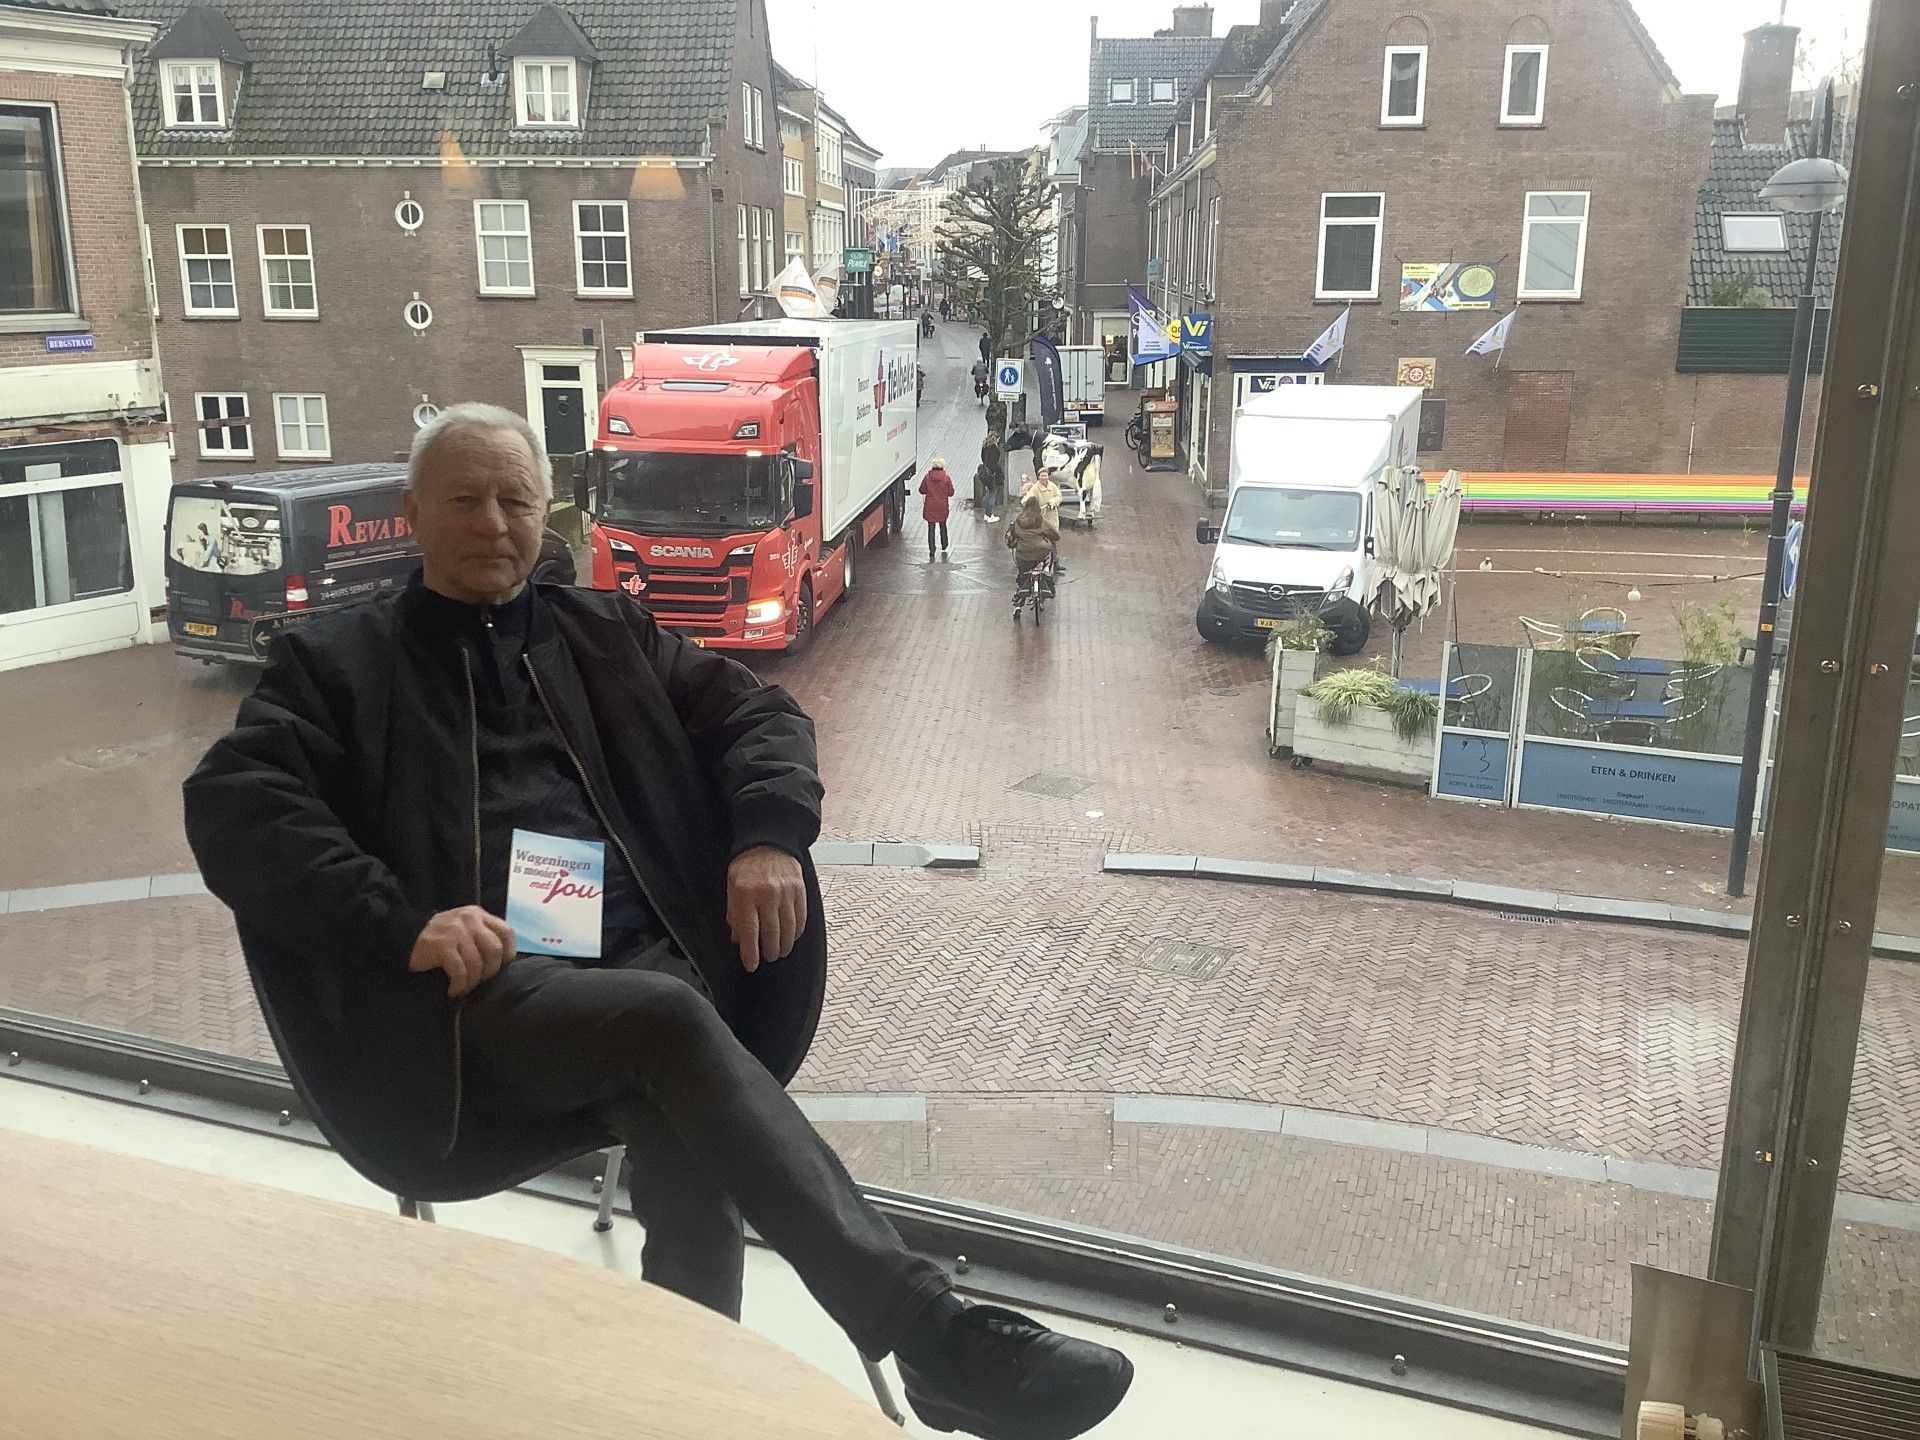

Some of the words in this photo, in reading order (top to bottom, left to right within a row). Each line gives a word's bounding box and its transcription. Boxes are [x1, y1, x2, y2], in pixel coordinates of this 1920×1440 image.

[1183, 316, 1208, 336] Vi
[49, 339, 92, 348] BERGSTRAAT
[327, 504, 391, 548] REVA
[649, 545, 713, 559] SCANIA
[1591, 765, 1616, 777] ETEN
[1618, 769, 1627, 778] &
[1629, 770, 1676, 783] DRINKEN
[1617, 791, 1644, 800] Dagkaart
[1655, 804, 1676, 813] VEGAN
[516, 849, 592, 871] Wageningen
[513, 862, 523, 874] is
[523, 866, 558, 880] mooier
[529, 881, 553, 890] met
[542, 869, 604, 904] jou
